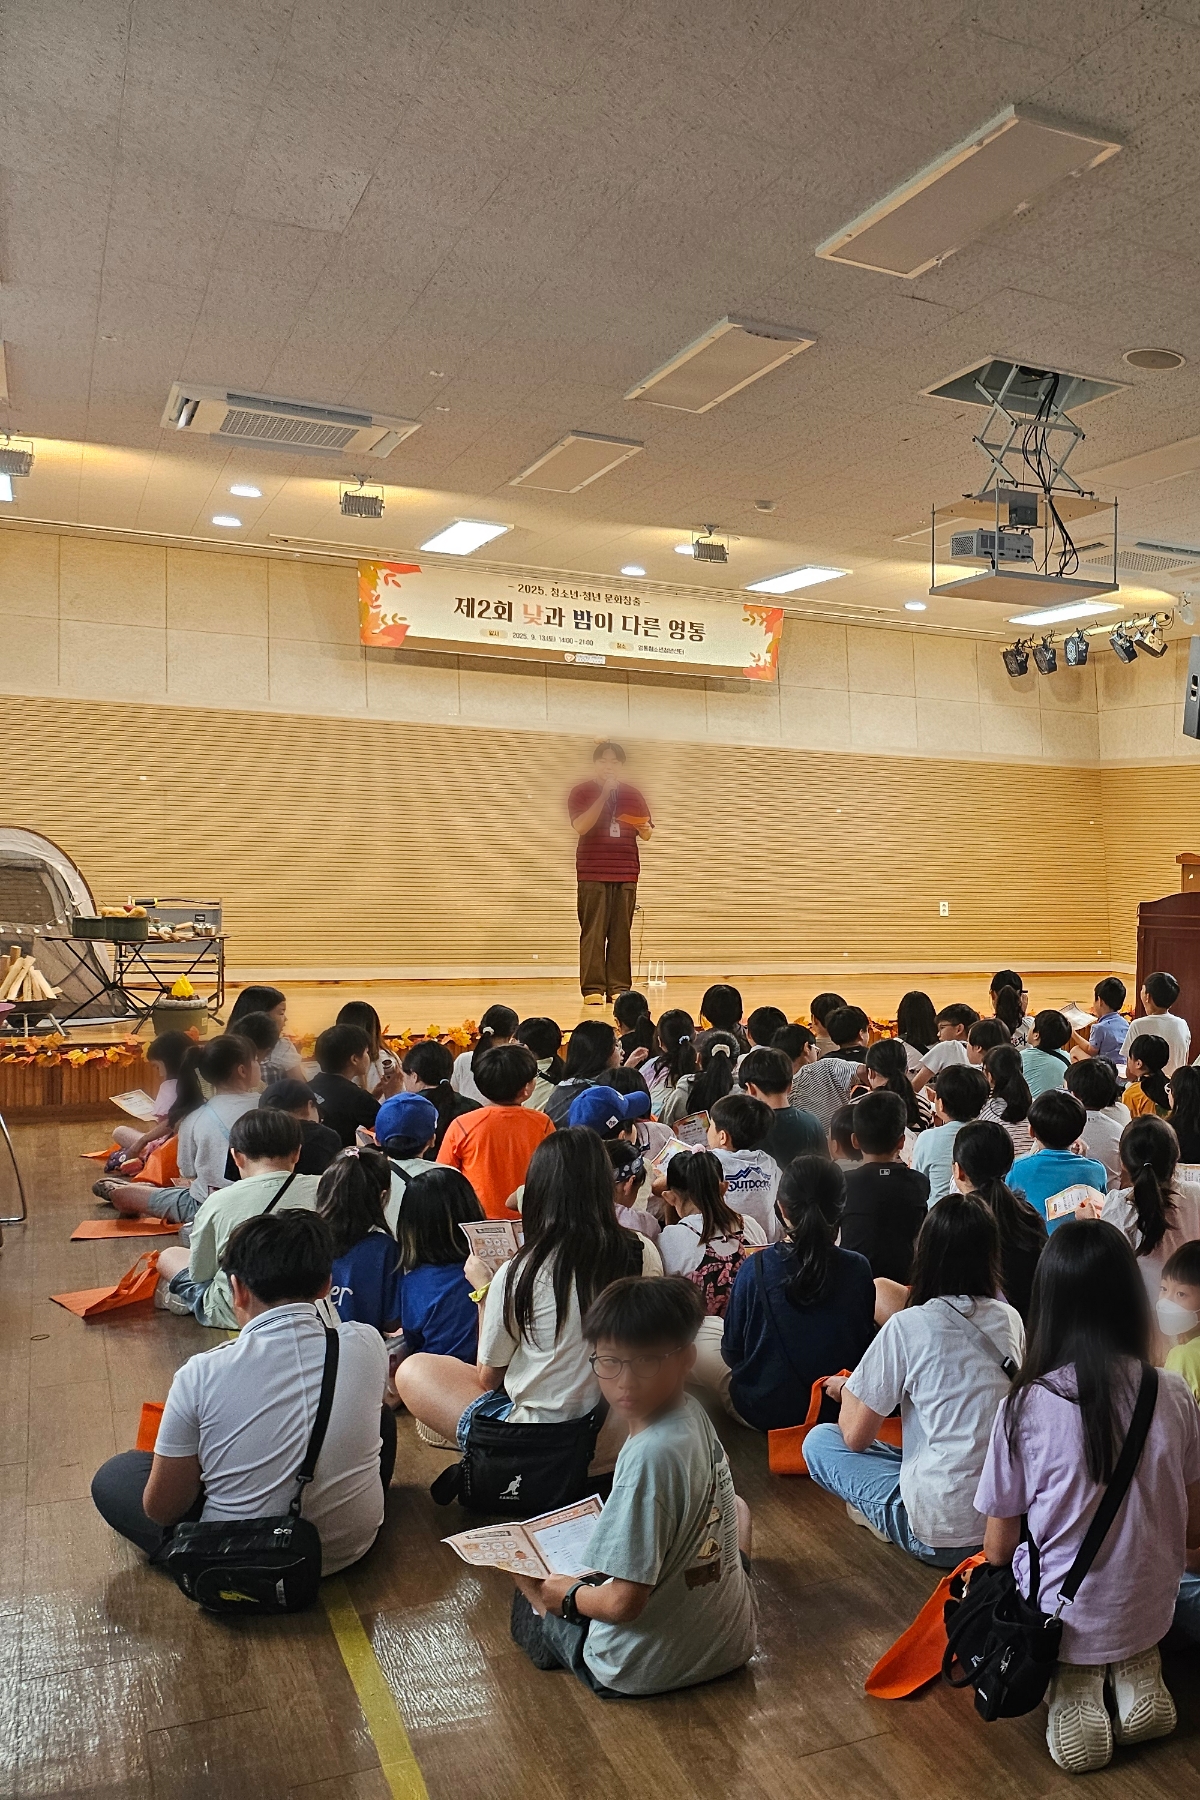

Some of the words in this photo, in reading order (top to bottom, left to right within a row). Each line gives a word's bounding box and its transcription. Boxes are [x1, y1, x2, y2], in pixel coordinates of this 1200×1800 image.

[517, 583, 548, 597] 2025.
[604, 593, 641, 607] 문화창출
[453, 597, 513, 623] 제2회
[522, 603, 566, 628] 낮과
[572, 609, 613, 633] 밤이
[621, 614, 661, 639] 다른
[668, 619, 707, 642] 영통
